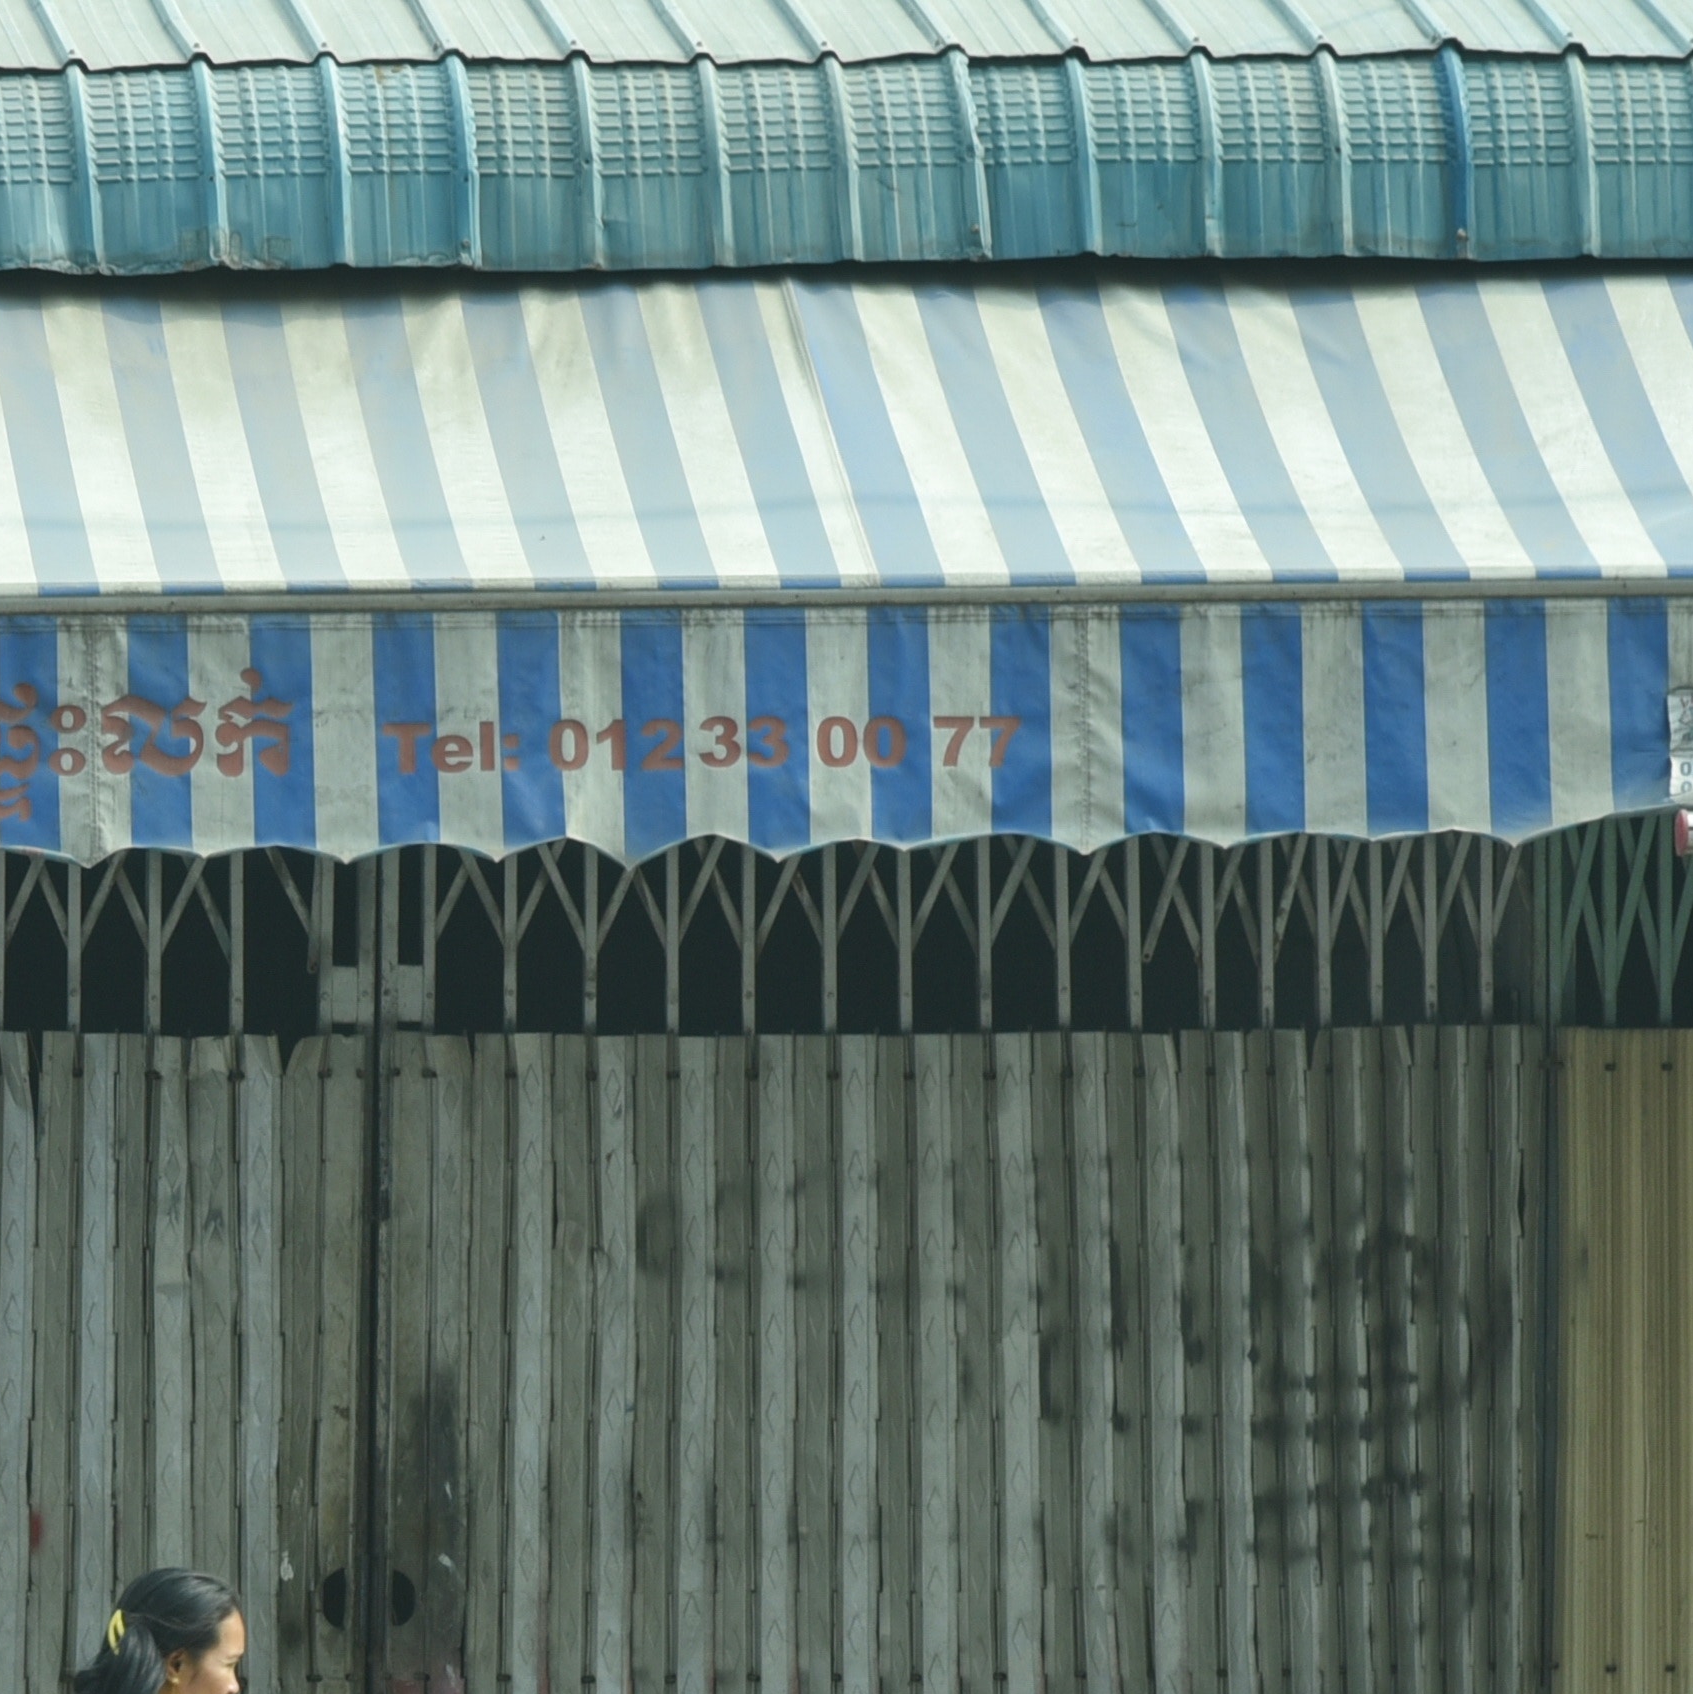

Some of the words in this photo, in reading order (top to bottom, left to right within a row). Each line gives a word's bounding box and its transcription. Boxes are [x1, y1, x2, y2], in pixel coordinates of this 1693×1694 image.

[382, 720, 521, 773] Tel:
[548, 718, 684, 771] 012
[699, 716, 790, 768] 33
[816, 716, 907, 768] 00
[933, 716, 1021, 768] 77
